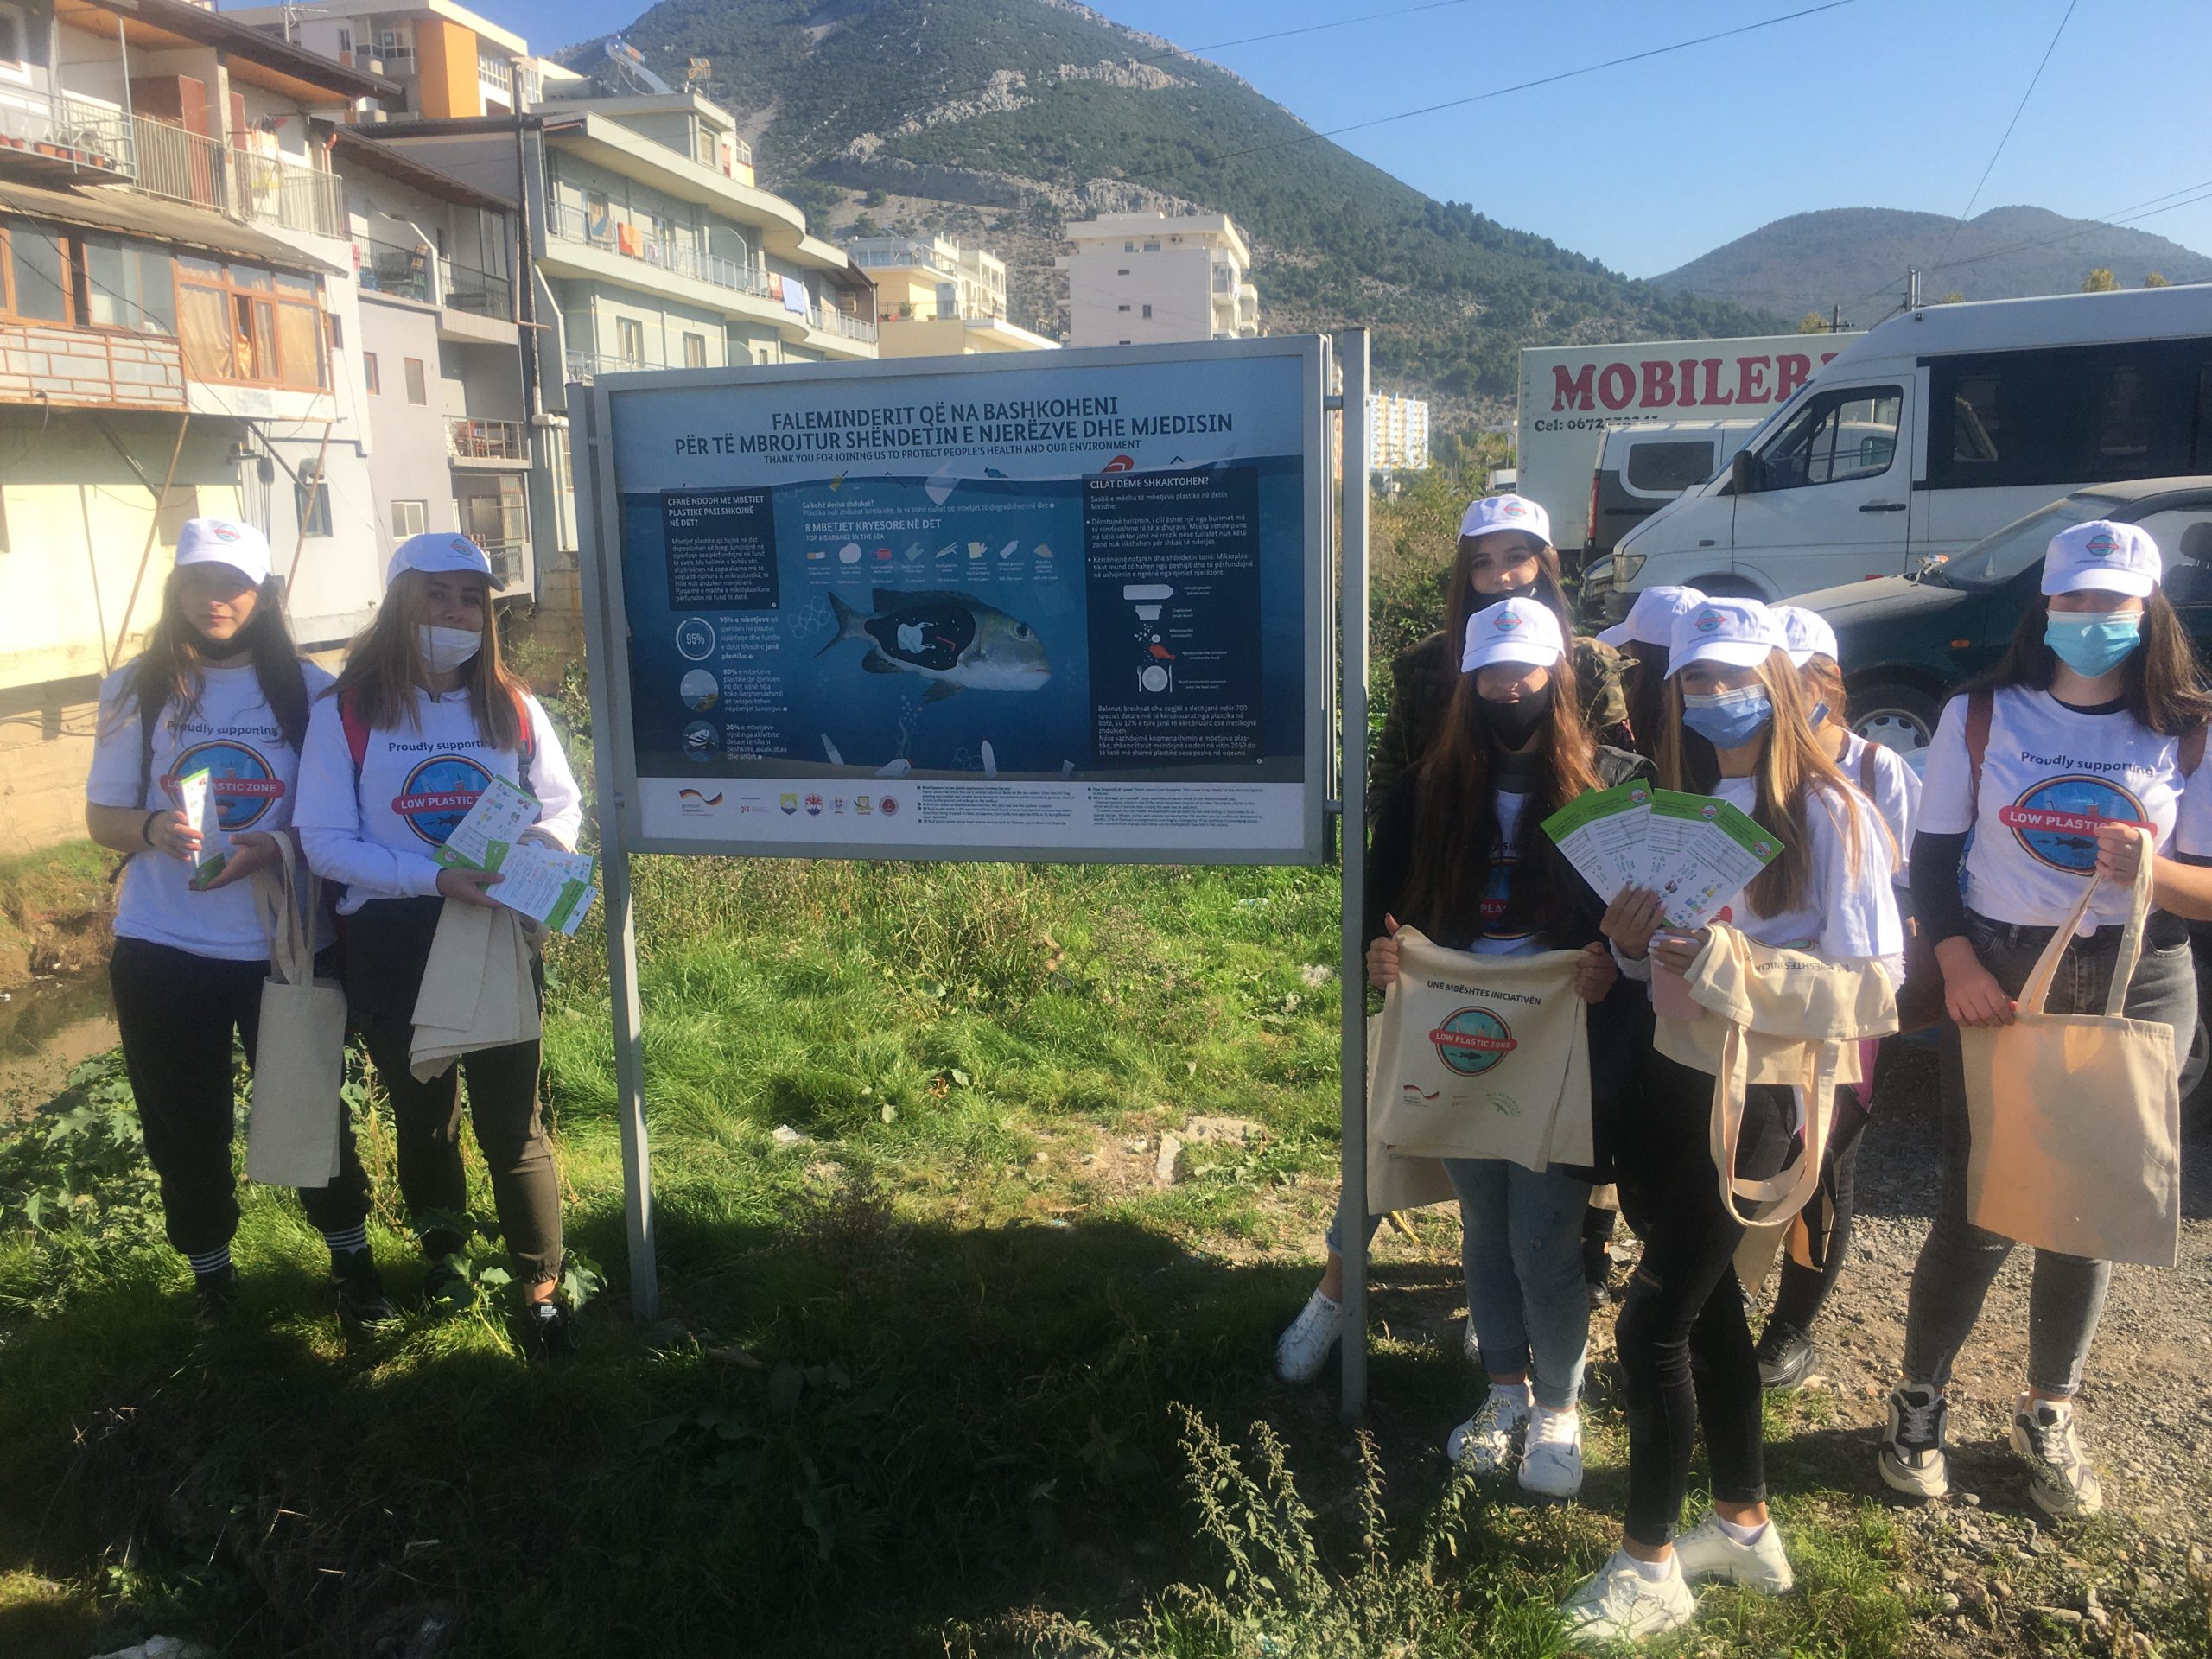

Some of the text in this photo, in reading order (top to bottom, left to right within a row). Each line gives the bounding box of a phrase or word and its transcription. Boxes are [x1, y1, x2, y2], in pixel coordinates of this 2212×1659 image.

[772, 397, 1118, 430] FALEMINDERIT QË NA BASHKOHENI
[1535, 418, 1562, 431] Cel:
[675, 413, 1232, 455] PËR TË MBROJTUR SHËNDETIN E NJERËZVE DHE MJEDISIN
[764, 455, 794, 464] THANK
[796, 454, 815, 463] YOU
[817, 454, 834, 462] FOR
[836, 452, 873, 462] JOINING
[888, 451, 900, 460] TO
[902, 448, 942, 459] PROTECT
[987, 445, 1022, 454] HEALTH
[1024, 444, 1044, 454] AND
[1046, 442, 1067, 452] OUR
[1069, 440, 1141, 452] ENVIRONMENT
[1116, 477, 1141, 487] DËME
[1143, 477, 1209, 486] SHKAKTOHEN?
[668, 496, 690, 507] ÇFARË
[733, 496, 764, 505] MBETJET
[721, 505, 753, 516] SHKOJNË
[670, 518, 679, 526] NË
[814, 523, 854, 533] MBETJET
[856, 521, 905, 531] KRYESORE
[907, 518, 920, 530] NË
[923, 520, 941, 529] DET
[686, 633, 705, 645] 95%
[167, 721, 278, 736] Proudly supporting
[389, 740, 496, 753] Proudly supporting
[2021, 751, 2153, 778] Proudly supporting
[167, 779, 181, 788] LO
[246, 783, 276, 792] ZONE
[401, 798, 425, 810] LOW
[428, 796, 473, 806] PLASTIC
[2010, 811, 2041, 825] LOW
[1427, 980, 1541, 1005] UNË MBËSHTES INICIATIVËN
[1436, 1033, 1454, 1042] LOW
[1455, 1036, 1488, 1047] PLASTIC
